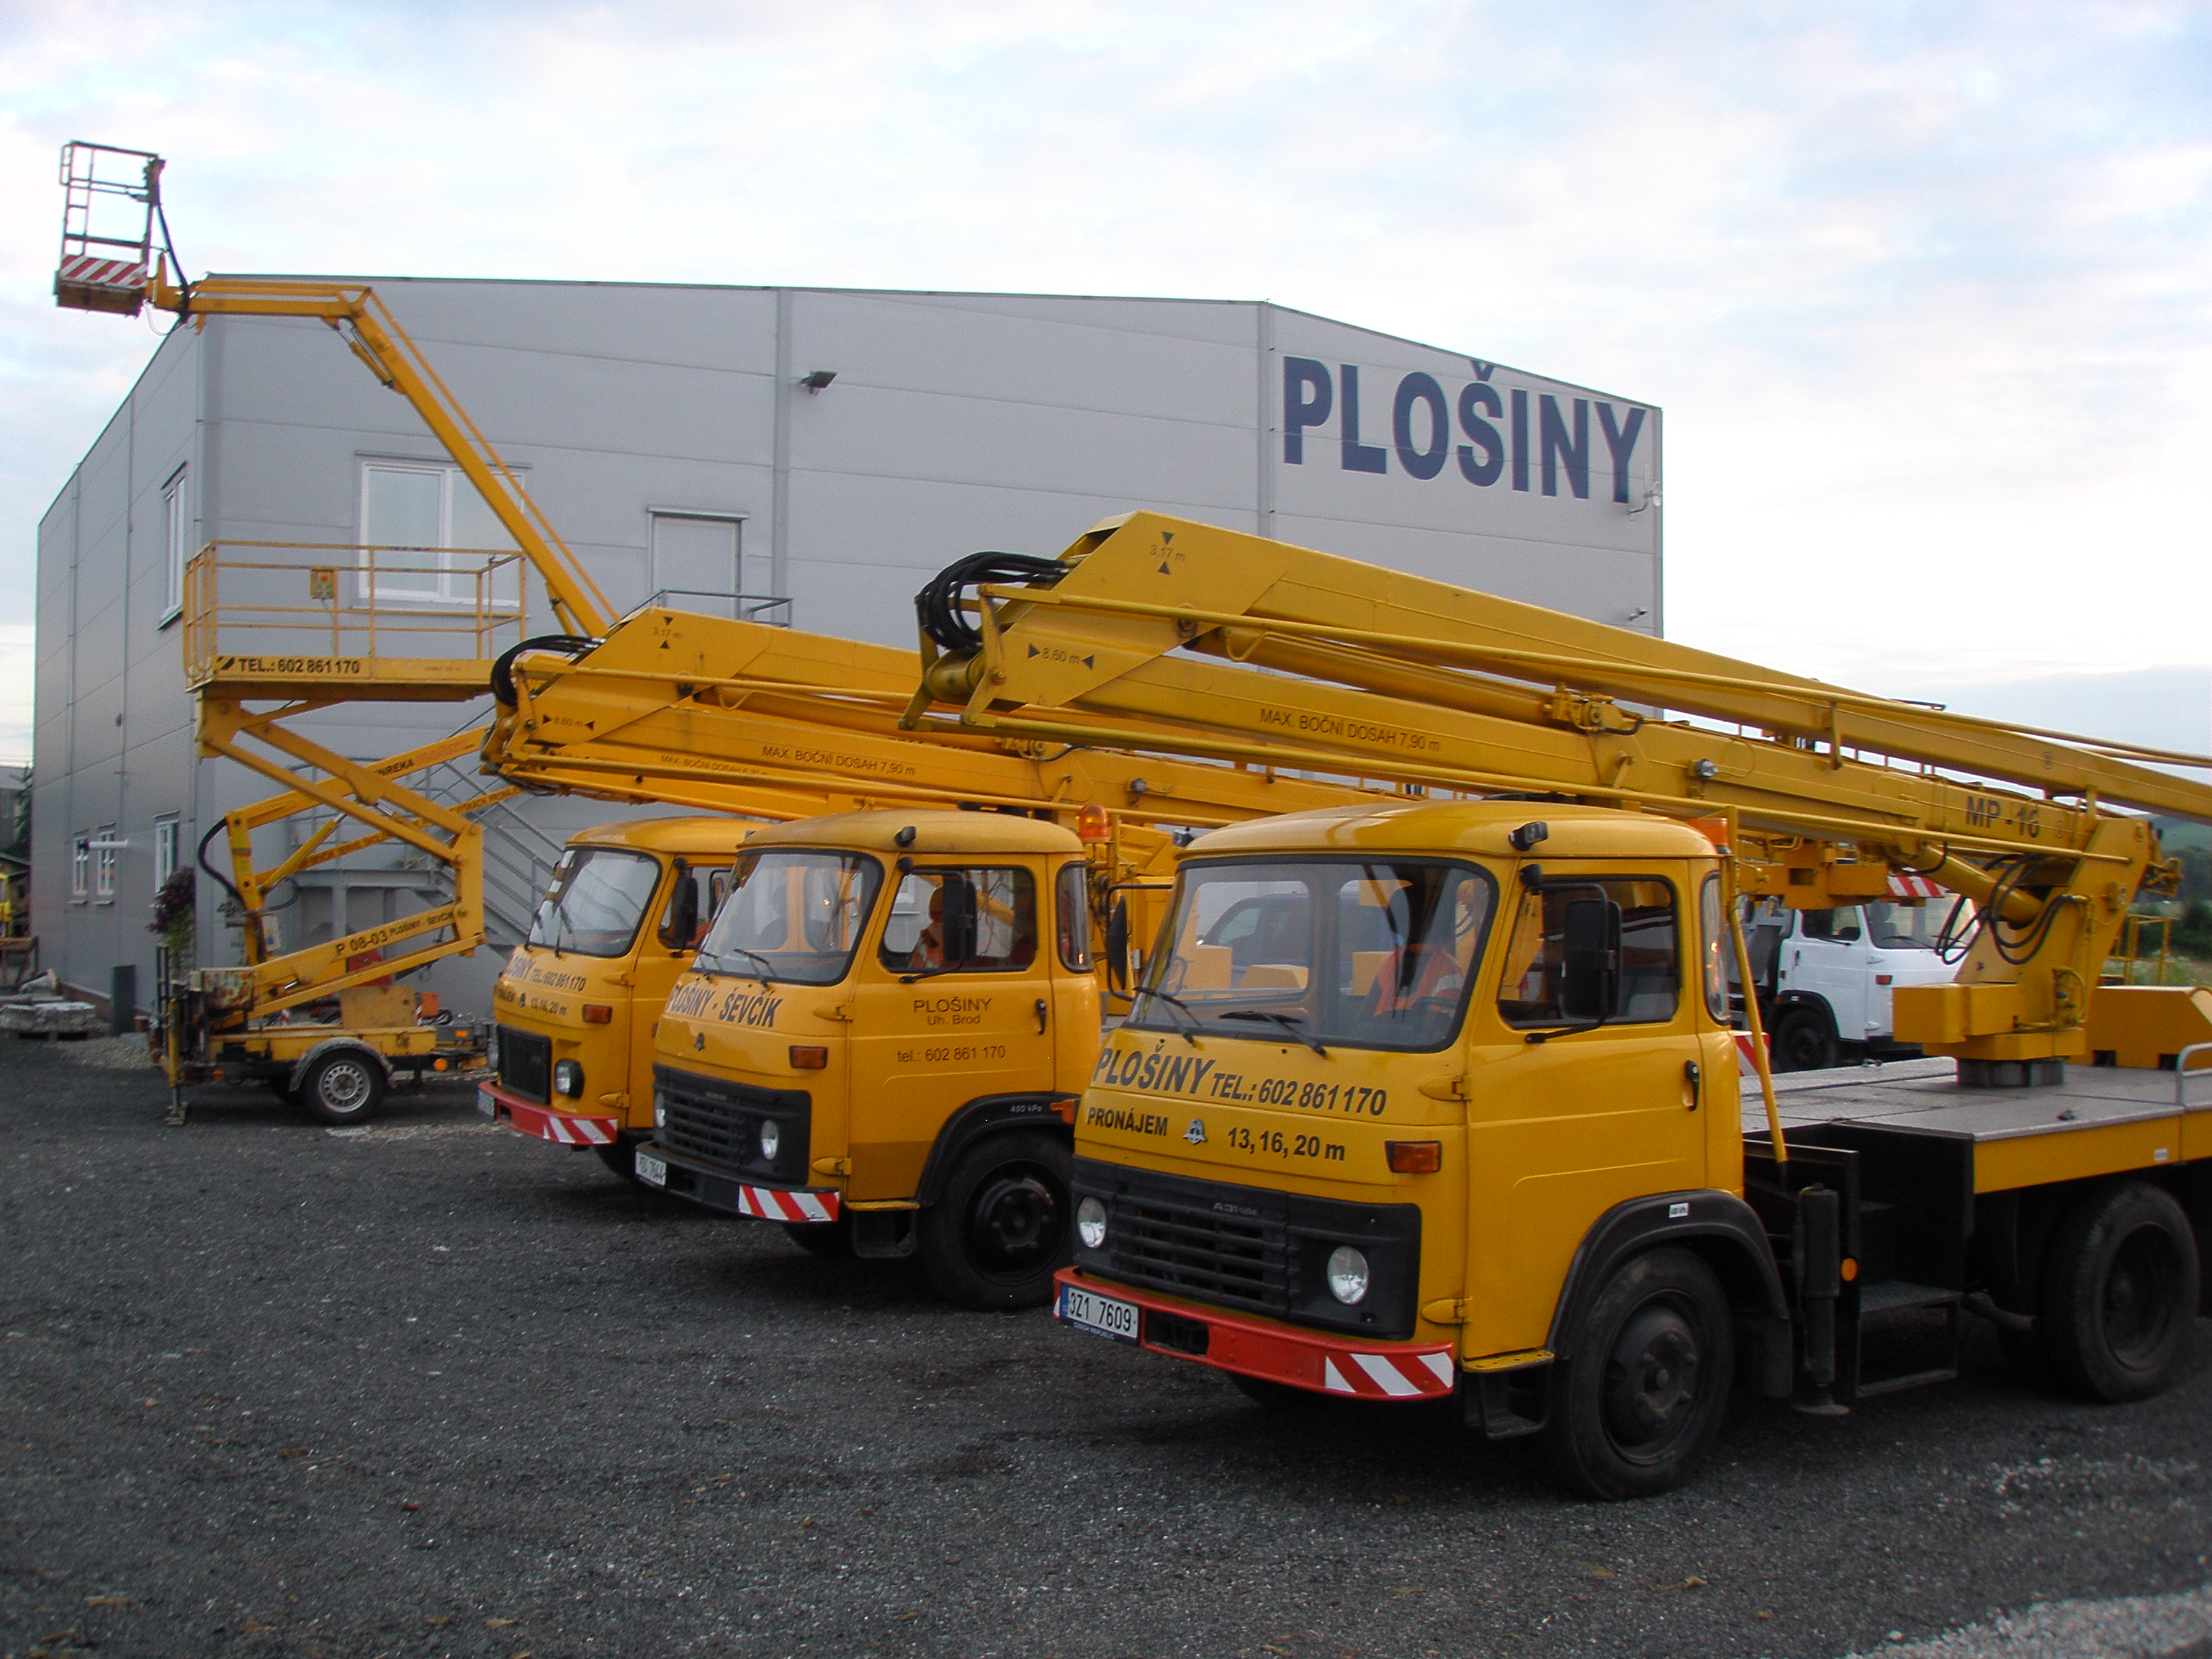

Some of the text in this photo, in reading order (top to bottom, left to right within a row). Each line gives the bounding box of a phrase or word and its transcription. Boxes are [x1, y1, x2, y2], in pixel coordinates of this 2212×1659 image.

[1283, 356, 1646, 503] PLOŠINY
[1150, 544, 1173, 559] 3,17
[276, 658, 303, 673] 602
[307, 659, 332, 674] 861
[334, 660, 360, 675] 170
[1260, 709, 1294, 727] MAX.
[1299, 715, 1345, 736] BOČNÍ
[1347, 724, 1395, 745] DOSAH
[1400, 733, 1426, 750] 7,90
[835, 756, 878, 770] DOSAH
[335, 943, 346, 956] P
[913, 997, 993, 1013] PLOŠINY
[927, 1015, 981, 1026] Uh. Brod
[897, 1045, 1006, 1063] tel.: 602 861 170
[1092, 1044, 1387, 1116] PLOŠINY TEL.: 602 861 170
[1087, 1106, 1169, 1137] PRONÁJEM
[1293, 1134, 1321, 1159] 20
[1324, 1142, 1345, 1161] m
[1069, 1292, 1132, 1332] 3Z1 7609
